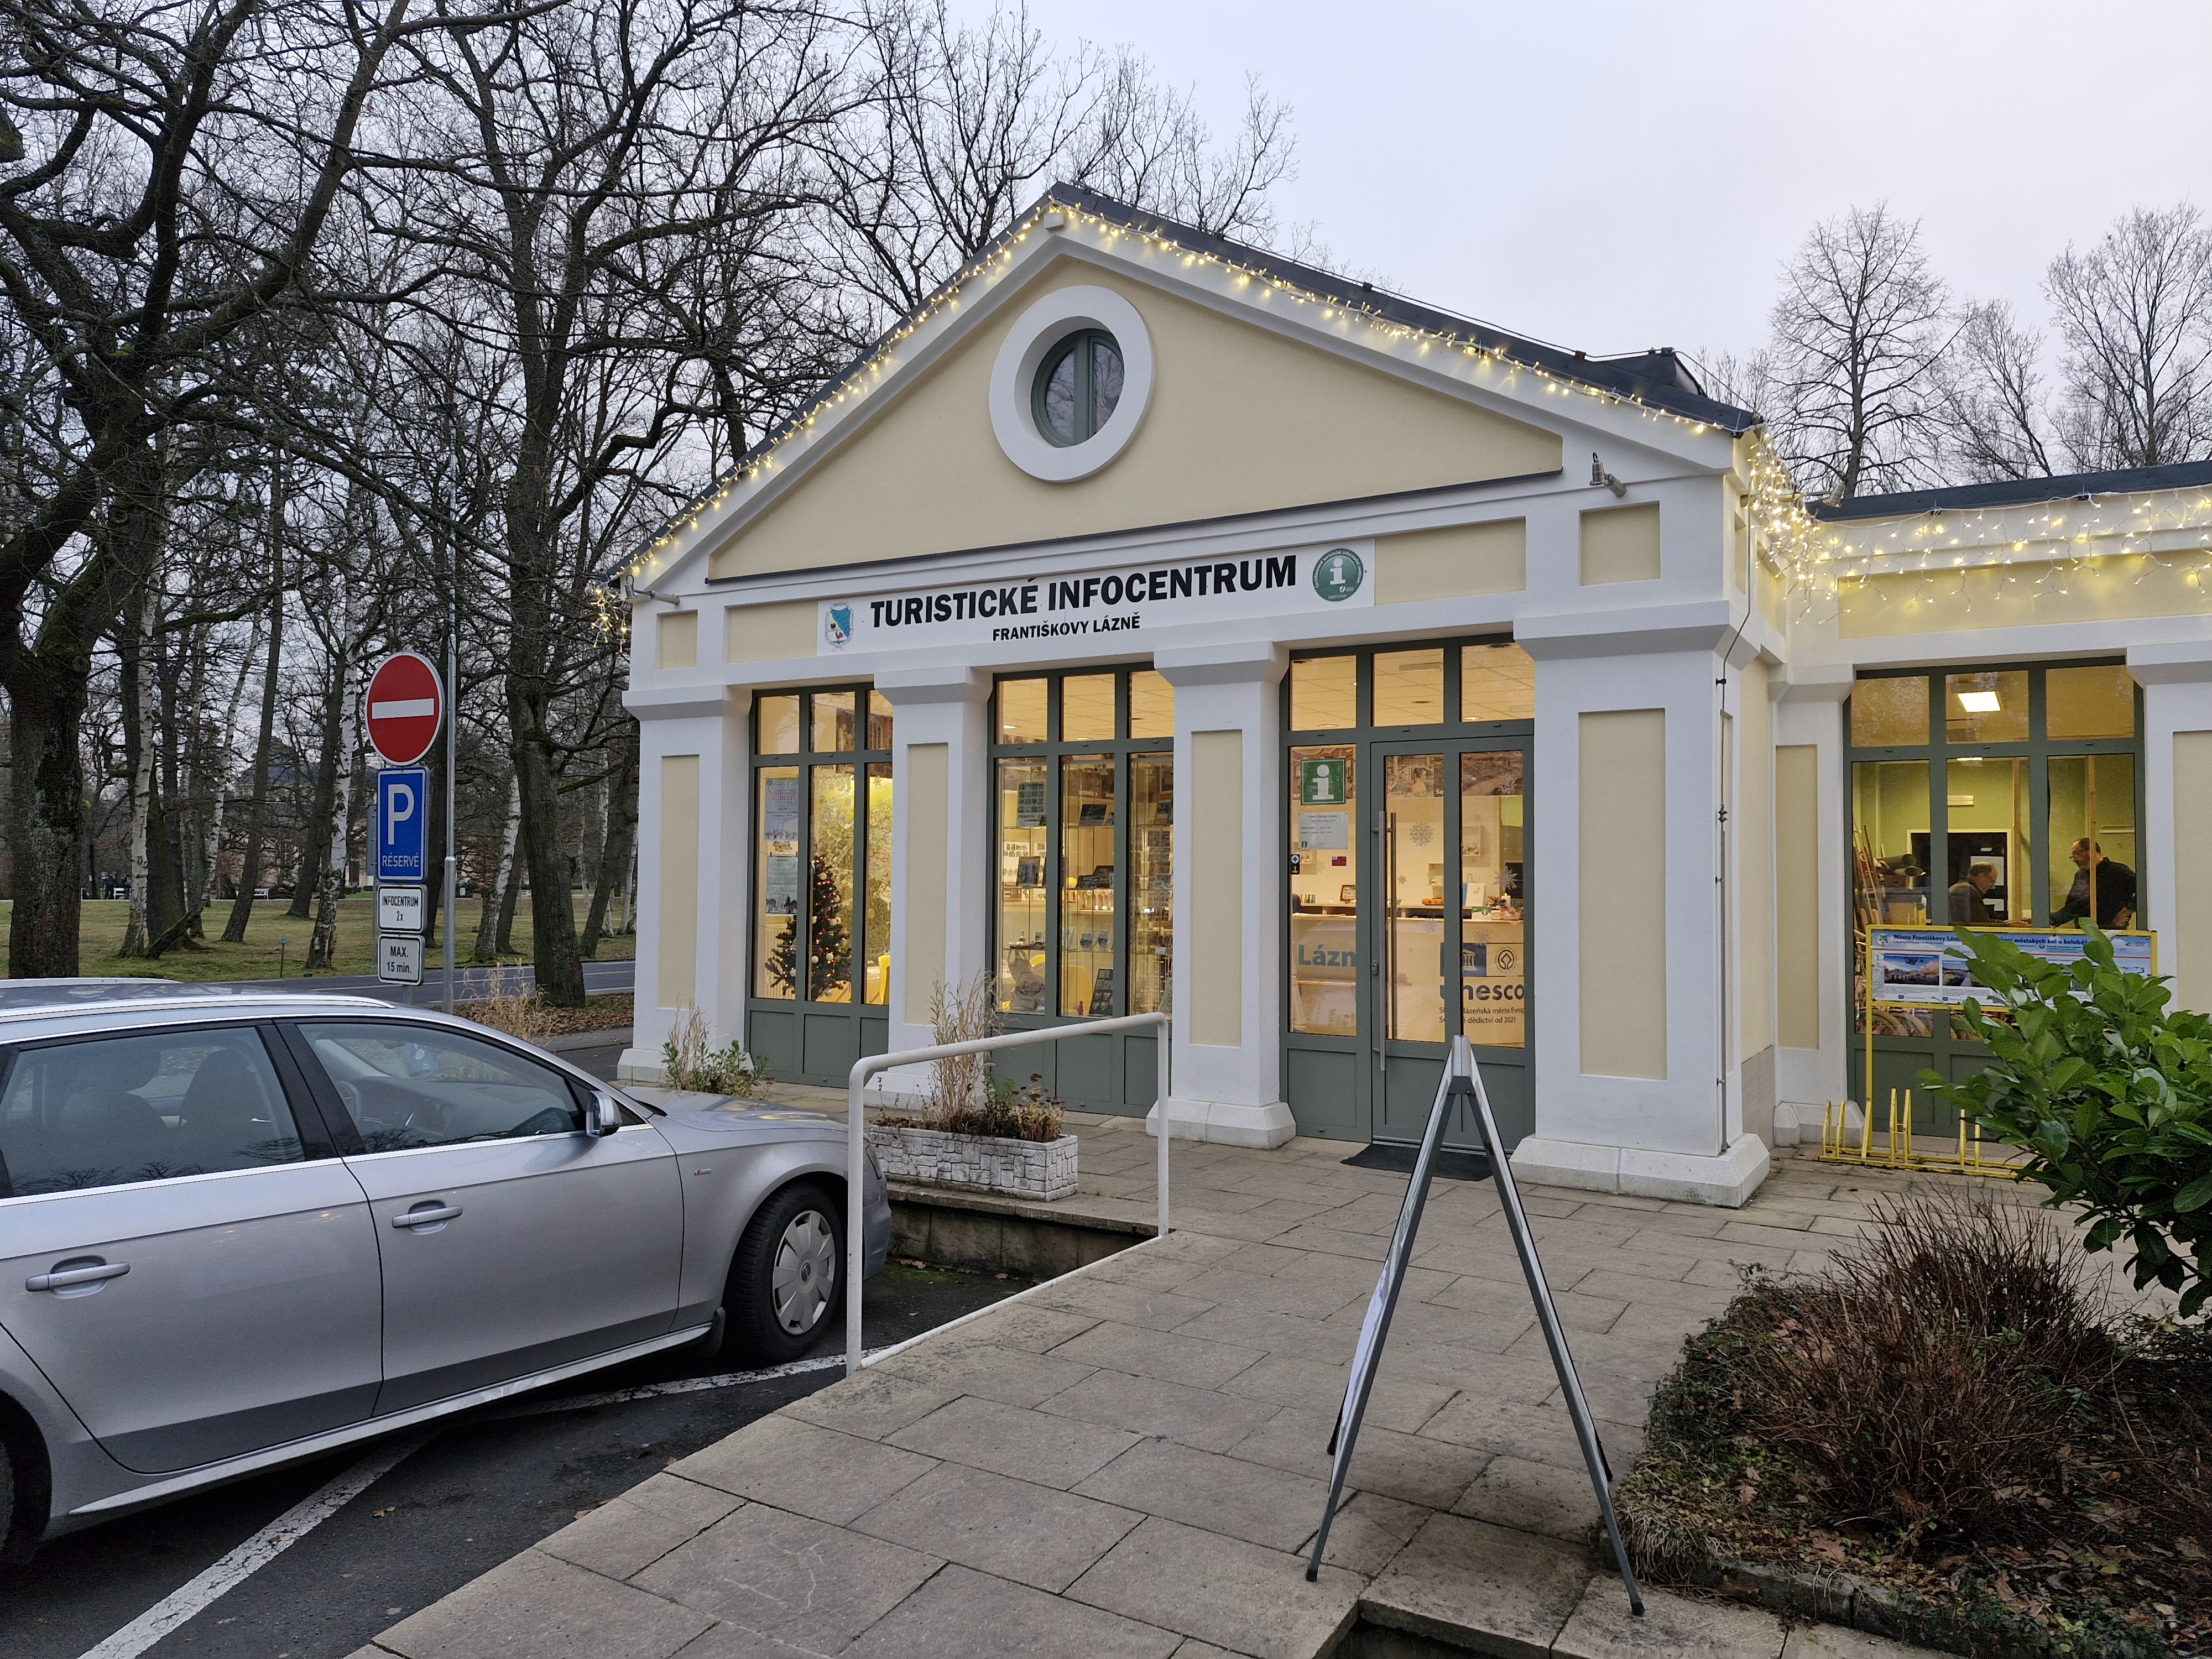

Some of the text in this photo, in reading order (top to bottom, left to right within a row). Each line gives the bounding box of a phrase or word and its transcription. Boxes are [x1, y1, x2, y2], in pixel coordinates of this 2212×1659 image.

[870, 578, 1038, 628] TURISTICKÉ
[1048, 555, 1296, 611] INFOCENTRUM
[993, 612, 1140, 641] FRANTIŠKOVY LÁZNĚ
[388, 784, 415, 845] P
[382, 852, 420, 867] RÉSERVÉ
[382, 895, 419, 907] INFOCENTRUM
[397, 911, 403, 921] 2x
[390, 946, 408, 957] MAX.
[387, 962, 411, 973] 15 min.
